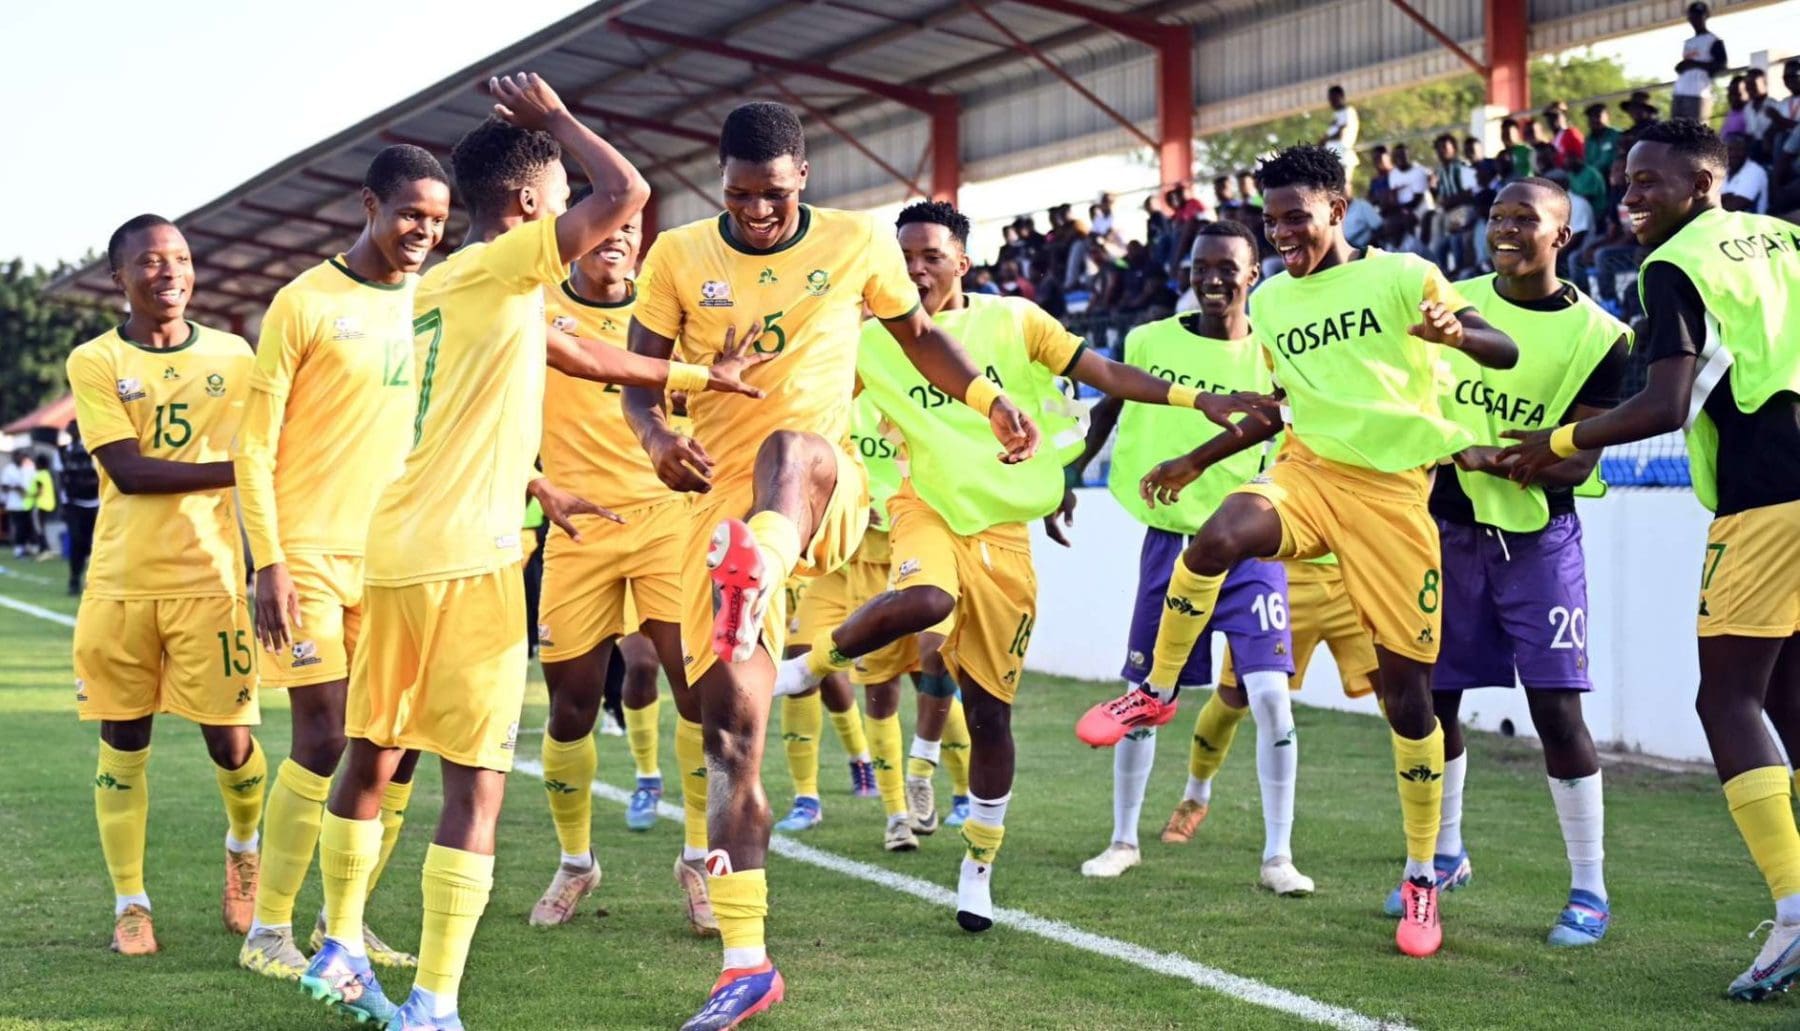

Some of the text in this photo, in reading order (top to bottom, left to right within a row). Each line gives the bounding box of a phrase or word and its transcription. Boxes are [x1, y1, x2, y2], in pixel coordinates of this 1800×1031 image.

[753, 310, 785, 353] 5
[1277, 307, 1382, 359] COSAFA
[153, 403, 192, 449] 15
[1455, 380, 1545, 427] COSAFA
[1251, 591, 1287, 631] 16
[1418, 568, 1439, 614] 8
[1548, 605, 1586, 650] 20
[217, 629, 252, 677] 15
